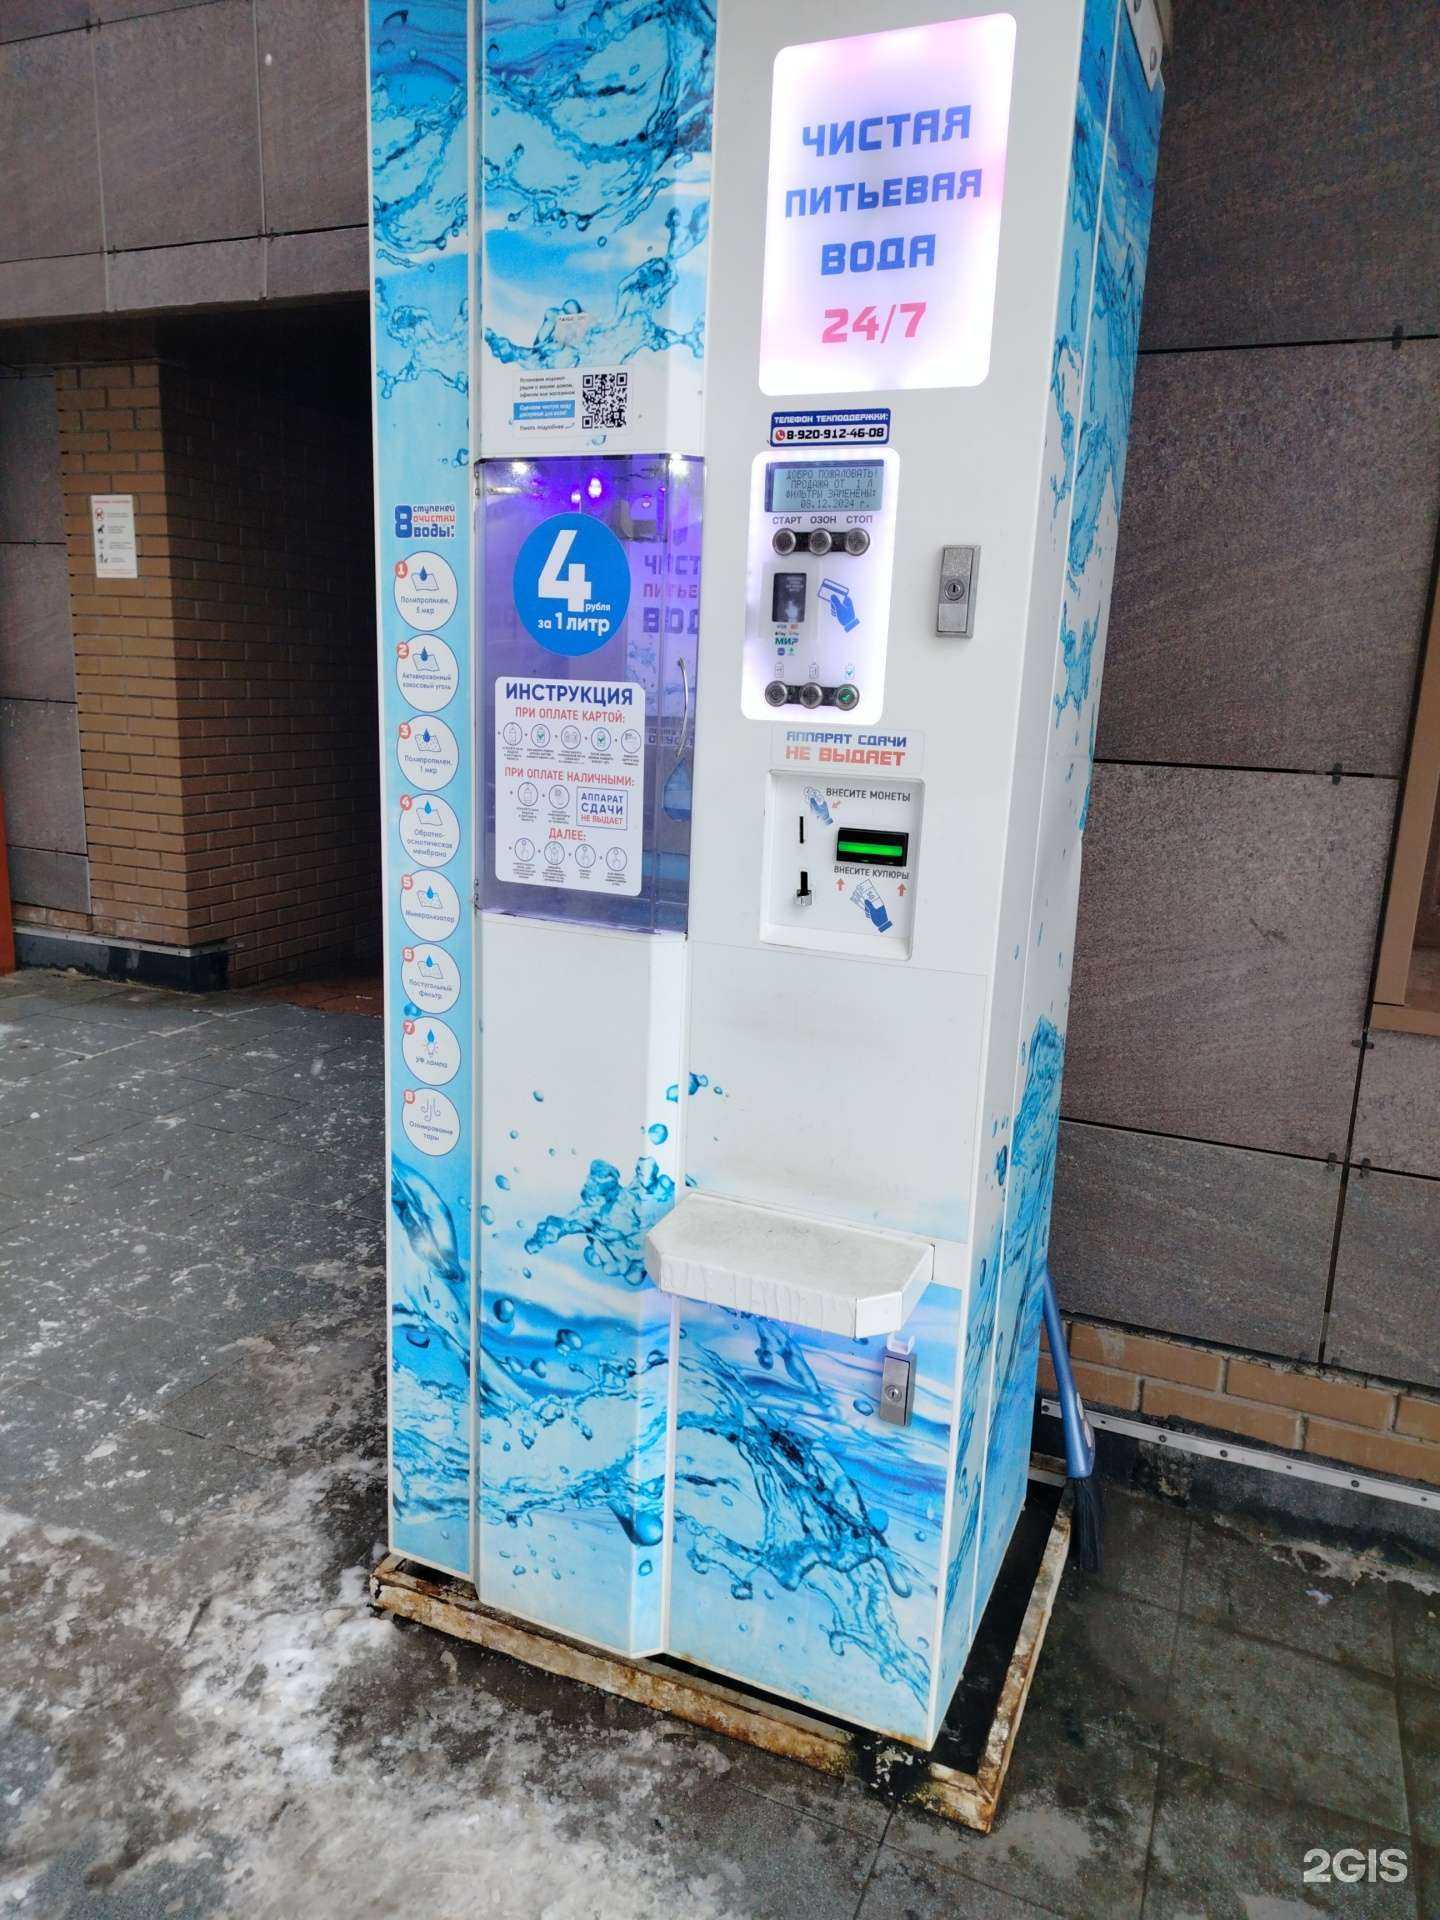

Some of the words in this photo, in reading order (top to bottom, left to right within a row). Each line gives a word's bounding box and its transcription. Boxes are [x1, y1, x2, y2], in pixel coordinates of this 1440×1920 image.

[802, 105, 971, 157] ЧИСТАЯ
[785, 169, 982, 218] ПИТЬЕВАЯ
[821, 234, 936, 275] ВОДА
[821, 302, 927, 344] 24/7
[774, 415, 813, 424] ТЕЛЕФОН
[816, 412, 889, 423] ТЕХПОДДЕРЖКИ:
[786, 427, 884, 440] 8-920-912-46-08
[833, 479, 846, 489] ОТ
[413, 504, 455, 514] ступеней
[395, 505, 413, 538] 8
[413, 514, 455, 523] очистки
[772, 516, 802, 525] СТАРТ
[810, 515, 836, 524] ОЗОН
[846, 514, 873, 524] СТОП
[413, 523, 455, 537] воды:
[538, 529, 592, 613] 4
[585, 602, 611, 612] рубля
[537, 619, 552, 629] за
[554, 611, 563, 630] 1
[566, 617, 610, 637] литр
[775, 637, 799, 646] МИР
[506, 683, 633, 707] ИНСТРУКЦИЯ
[515, 706, 536, 718] ПРИ
[539, 708, 579, 721] ОПЛАТЕ
[582, 709, 625, 724] КАРТОЙ:
[786, 730, 852, 745] АППАРАТ
[858, 734, 907, 748] СДАЧИ
[785, 745, 810, 760] НЕ
[819, 747, 906, 767] ВЫДАЕТ
[504, 766, 524, 777] ПРИ
[527, 768, 564, 781] ОПЛАТЕ
[567, 771, 635, 787] НАЛИЧНЫМИ:
[581, 792, 624, 804] АППАРАТ
[826, 787, 867, 799] ВНЕСИТЕ
[870, 790, 911, 803] МОНЕТЫ
[581, 802, 623, 816] СДАЧИ
[581, 814, 592, 823] НЕ
[592, 815, 624, 825] ВЫДАЕТ
[549, 827, 586, 842] ДАЛЕЕ:
[833, 865, 870, 877] ВНЕСИТЕ
[872, 868, 910, 880] КУПЮРЫ
